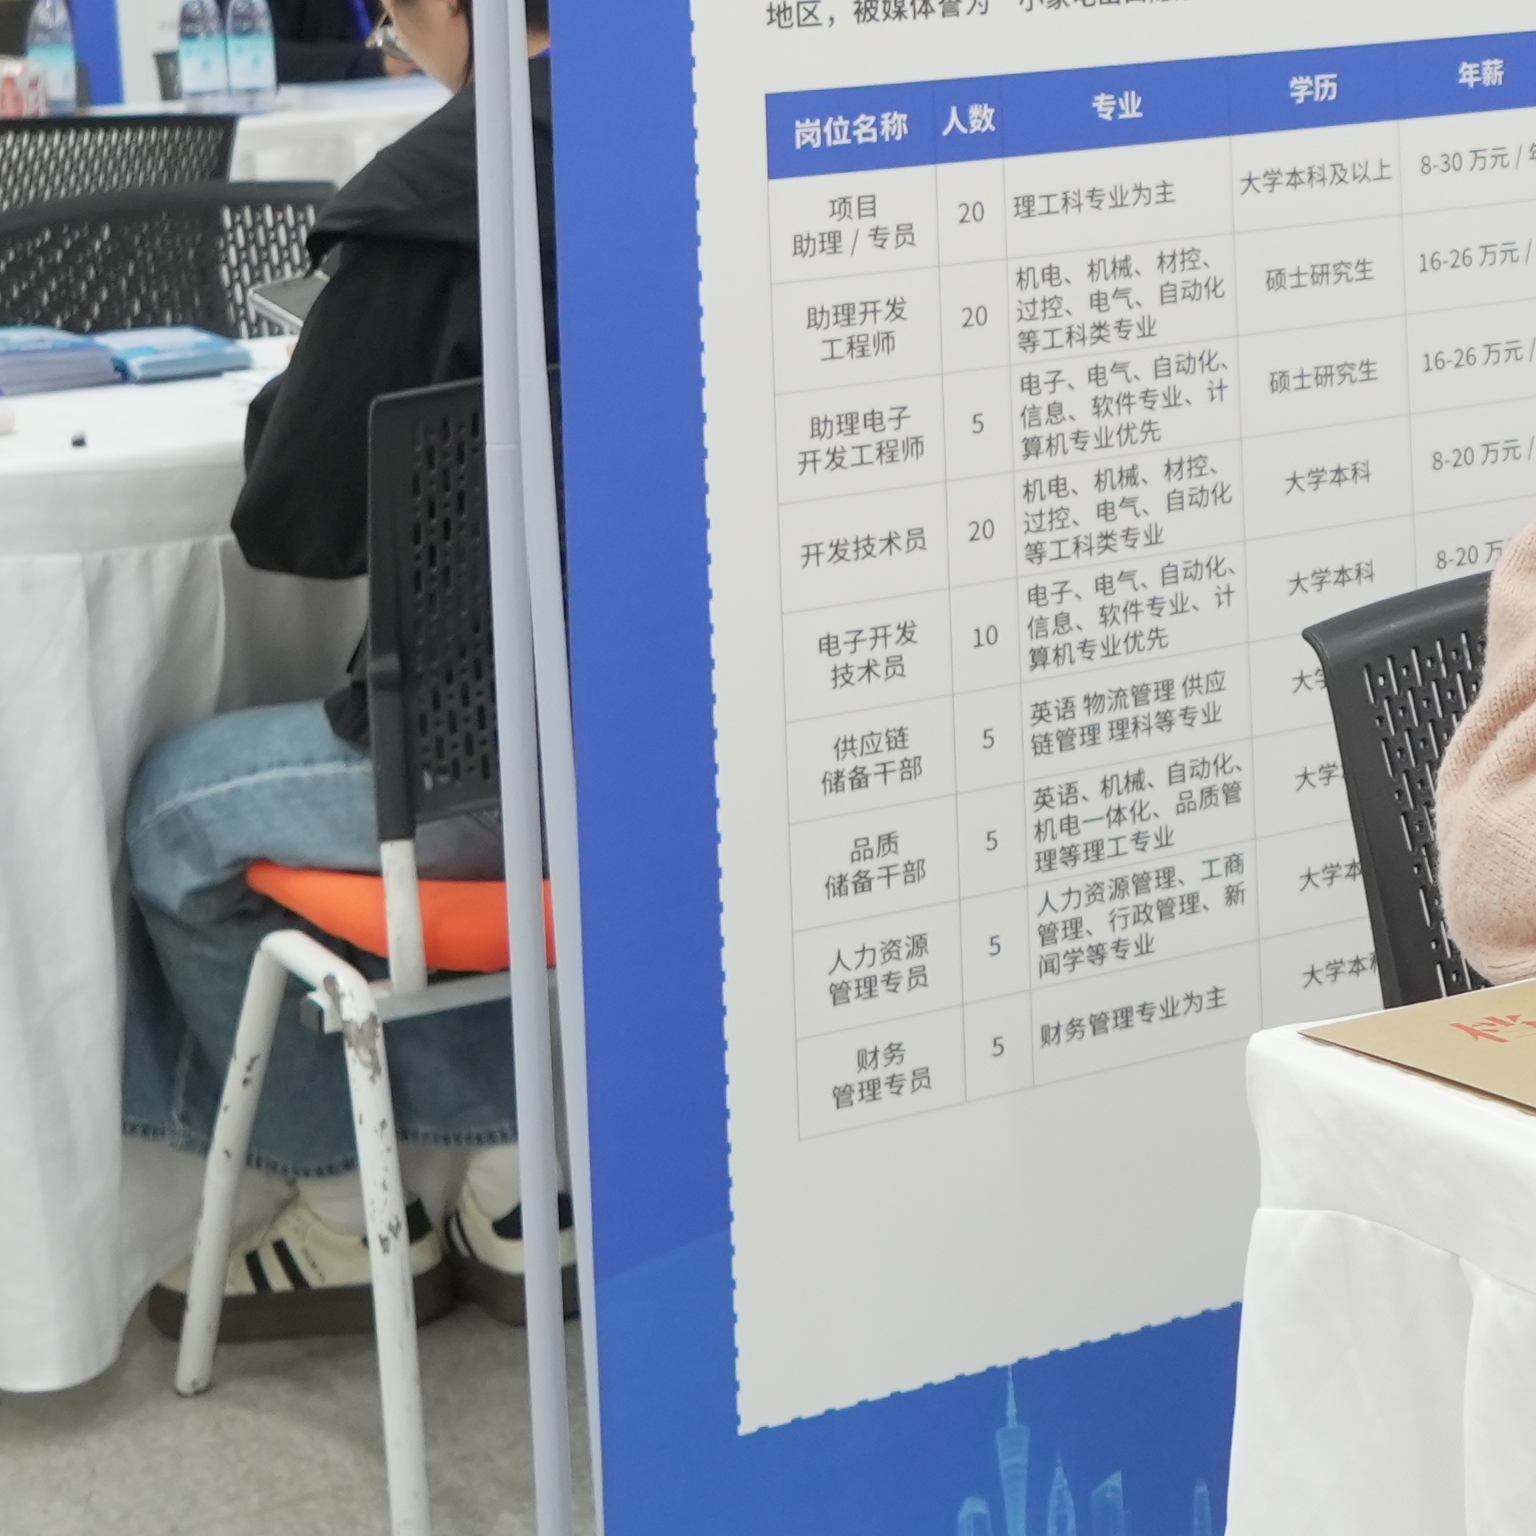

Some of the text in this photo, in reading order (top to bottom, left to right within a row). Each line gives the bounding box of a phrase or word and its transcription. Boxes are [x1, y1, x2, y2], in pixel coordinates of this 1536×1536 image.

[795, 59, 1504, 149] 岗位名称 人数 专业 学历 年薪
[1241, 158, 1392, 195] 大学本科及以上
[1421, 152, 1462, 175] 8-30
[1469, 147, 1509, 171] 万元
[1515, 145, 1522, 170] /
[829, 195, 876, 221] 项目
[959, 201, 984, 224] 20
[1014, 180, 1175, 219] 理工科专业为主
[793, 223, 915, 257] 助理 / 专员
[1420, 248, 1472, 272] 16-26
[1479, 242, 1519, 267] 万元
[1525, 239, 1532, 264] /
[1016, 247, 1209, 291] 机电、机械、材控、
[1266, 258, 1374, 292] 硕士研究生
[807, 297, 907, 330] 助理开发
[962, 305, 987, 328] 20
[1017, 276, 1225, 322] 过控、电气、自动化
[821, 331, 895, 361] 工程师
[1018, 315, 1156, 353] 等工科类专业
[1021, 349, 1227, 396] 电子、电气、自动化、
[1270, 359, 1378, 394] 硕士研究生
[1020, 379, 1228, 429] 信息、软件专业、计
[810, 406, 910, 440] 助理电子
[973, 413, 984, 434] 5
[1022, 419, 1161, 461] 算机专业优先
[799, 436, 924, 475] 开发工程师
[1285, 460, 1371, 494] 大学本科
[801, 528, 926, 568] 开发技术员
[819, 620, 917, 657] 电子开发
[831, 655, 905, 689] 技术员
[1031, 670, 1226, 726] 英语 物流管理 供应
[833, 726, 909, 761] 供应链
[1031, 701, 1221, 757] 链管理 理科等专业
[822, 756, 922, 795] 储备干部
[1041, 986, 1226, 1047] 财务管理专业为主
[857, 1042, 905, 1073] 财务
[832, 1067, 931, 1110] 管理专员
